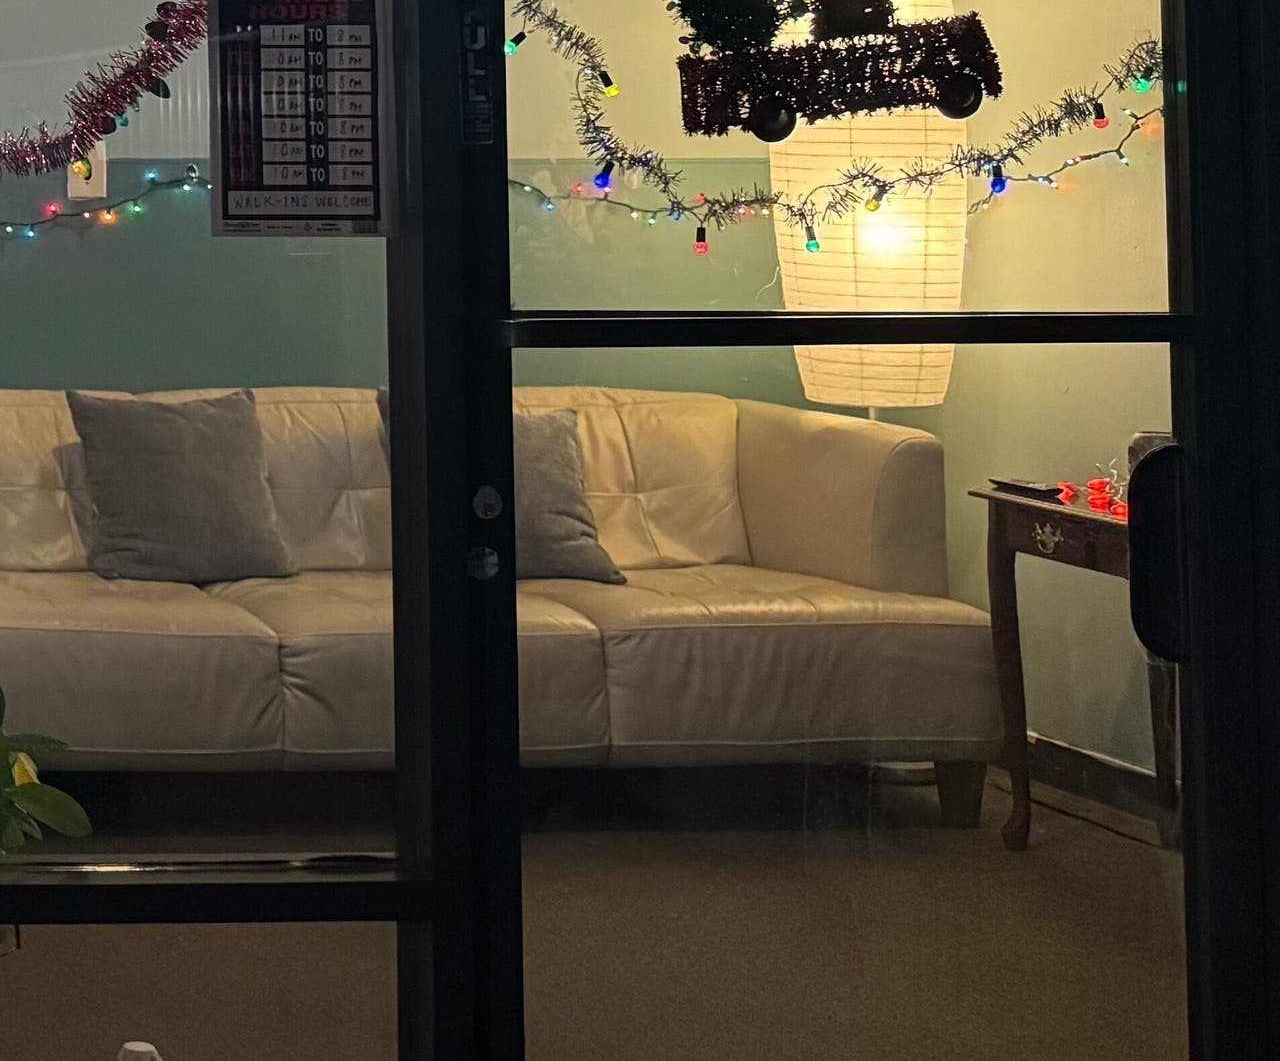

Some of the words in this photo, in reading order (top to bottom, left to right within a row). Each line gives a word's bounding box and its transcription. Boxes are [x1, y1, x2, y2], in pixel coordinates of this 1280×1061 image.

[308, 28, 323, 42] TO
[308, 51, 324, 66] TO
[308, 74, 324, 88] TO
[309, 98, 324, 112] TO
[309, 121, 324, 135] TO
[310, 144, 325, 158] TO
[310, 168, 325, 182] TO
